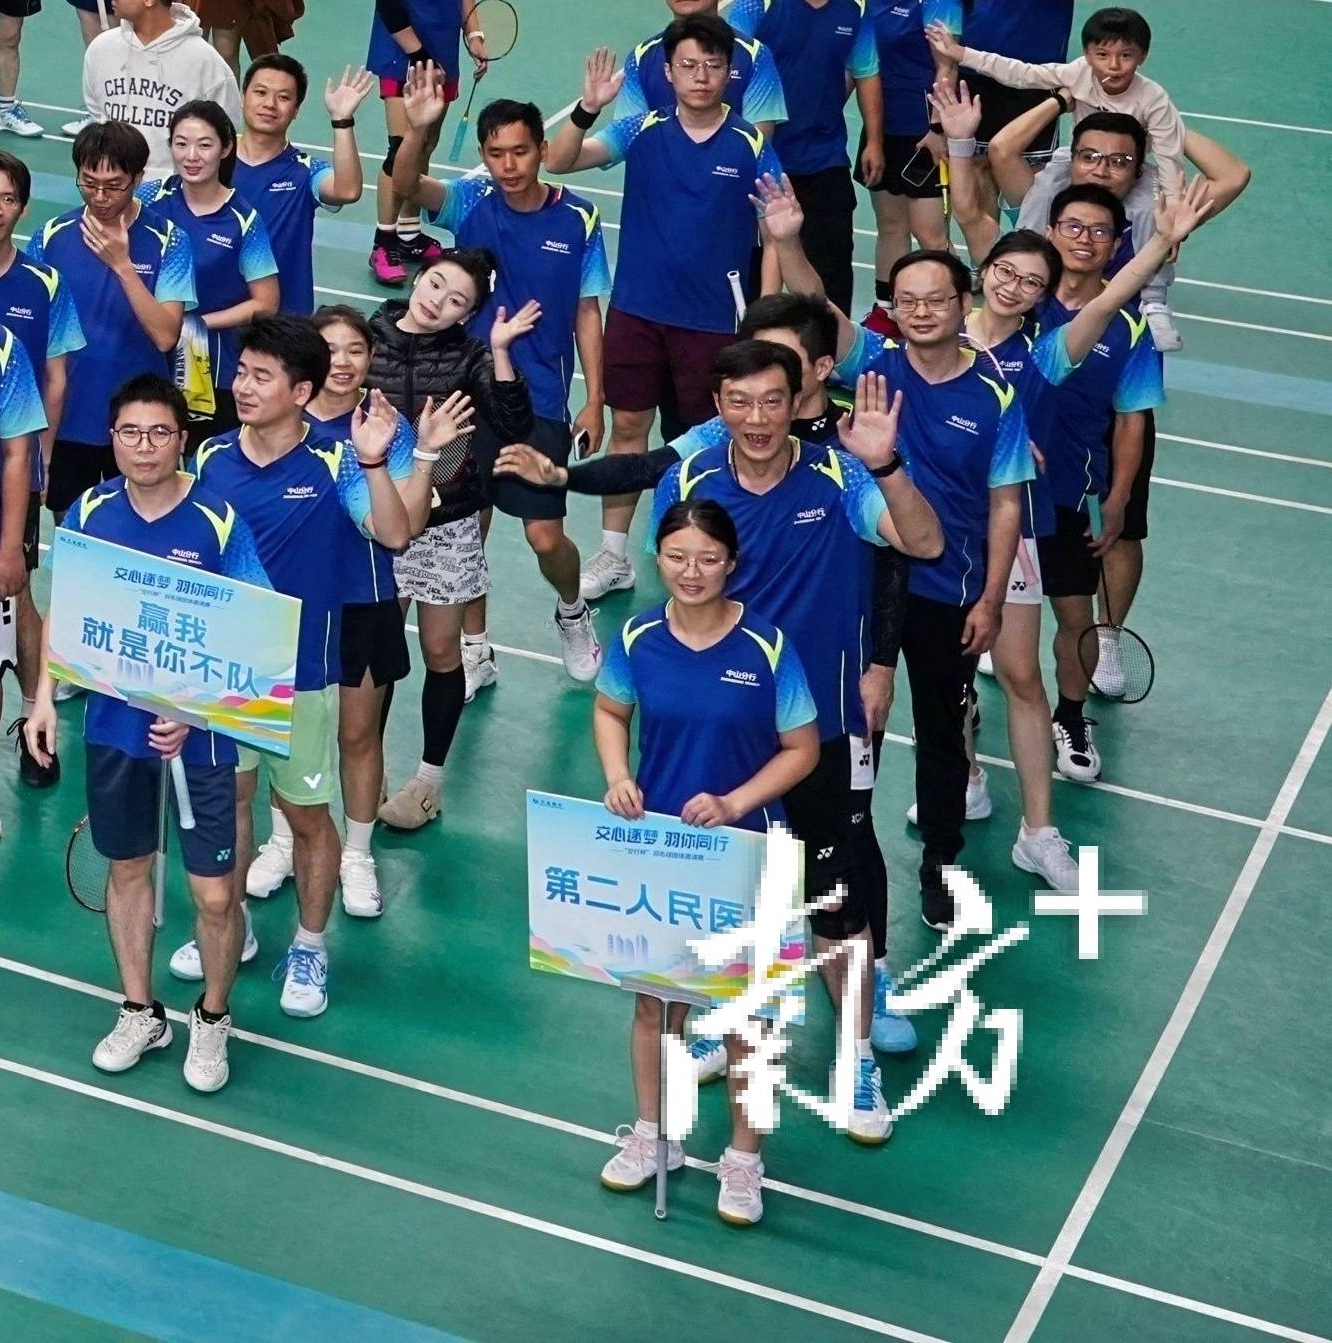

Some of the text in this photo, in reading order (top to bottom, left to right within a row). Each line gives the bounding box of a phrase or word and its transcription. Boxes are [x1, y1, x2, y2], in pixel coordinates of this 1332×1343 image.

[104, 77, 183, 107] CHARM'S
[716, 166, 738, 174] 中山分行
[212, 234, 232, 244] 中山分行
[546, 240, 569, 250] 中山分行
[10, 307, 32, 315] 中山分行
[951, 415, 977, 429] 中山分行
[287, 487, 314, 495] 中山分行
[798, 508, 826, 518] 中山分行
[172, 549, 199, 560] 中山分行
[113, 567, 234, 603] 交心逐梦 羽你同行
[137, 601, 207, 648] 赢我
[82, 616, 260, 699] 就是你不队
[726, 670, 757, 681] 中山分行
[594, 824, 729, 853] 交心逐梦 羽你同行
[545, 866, 747, 933] 第二人民医
